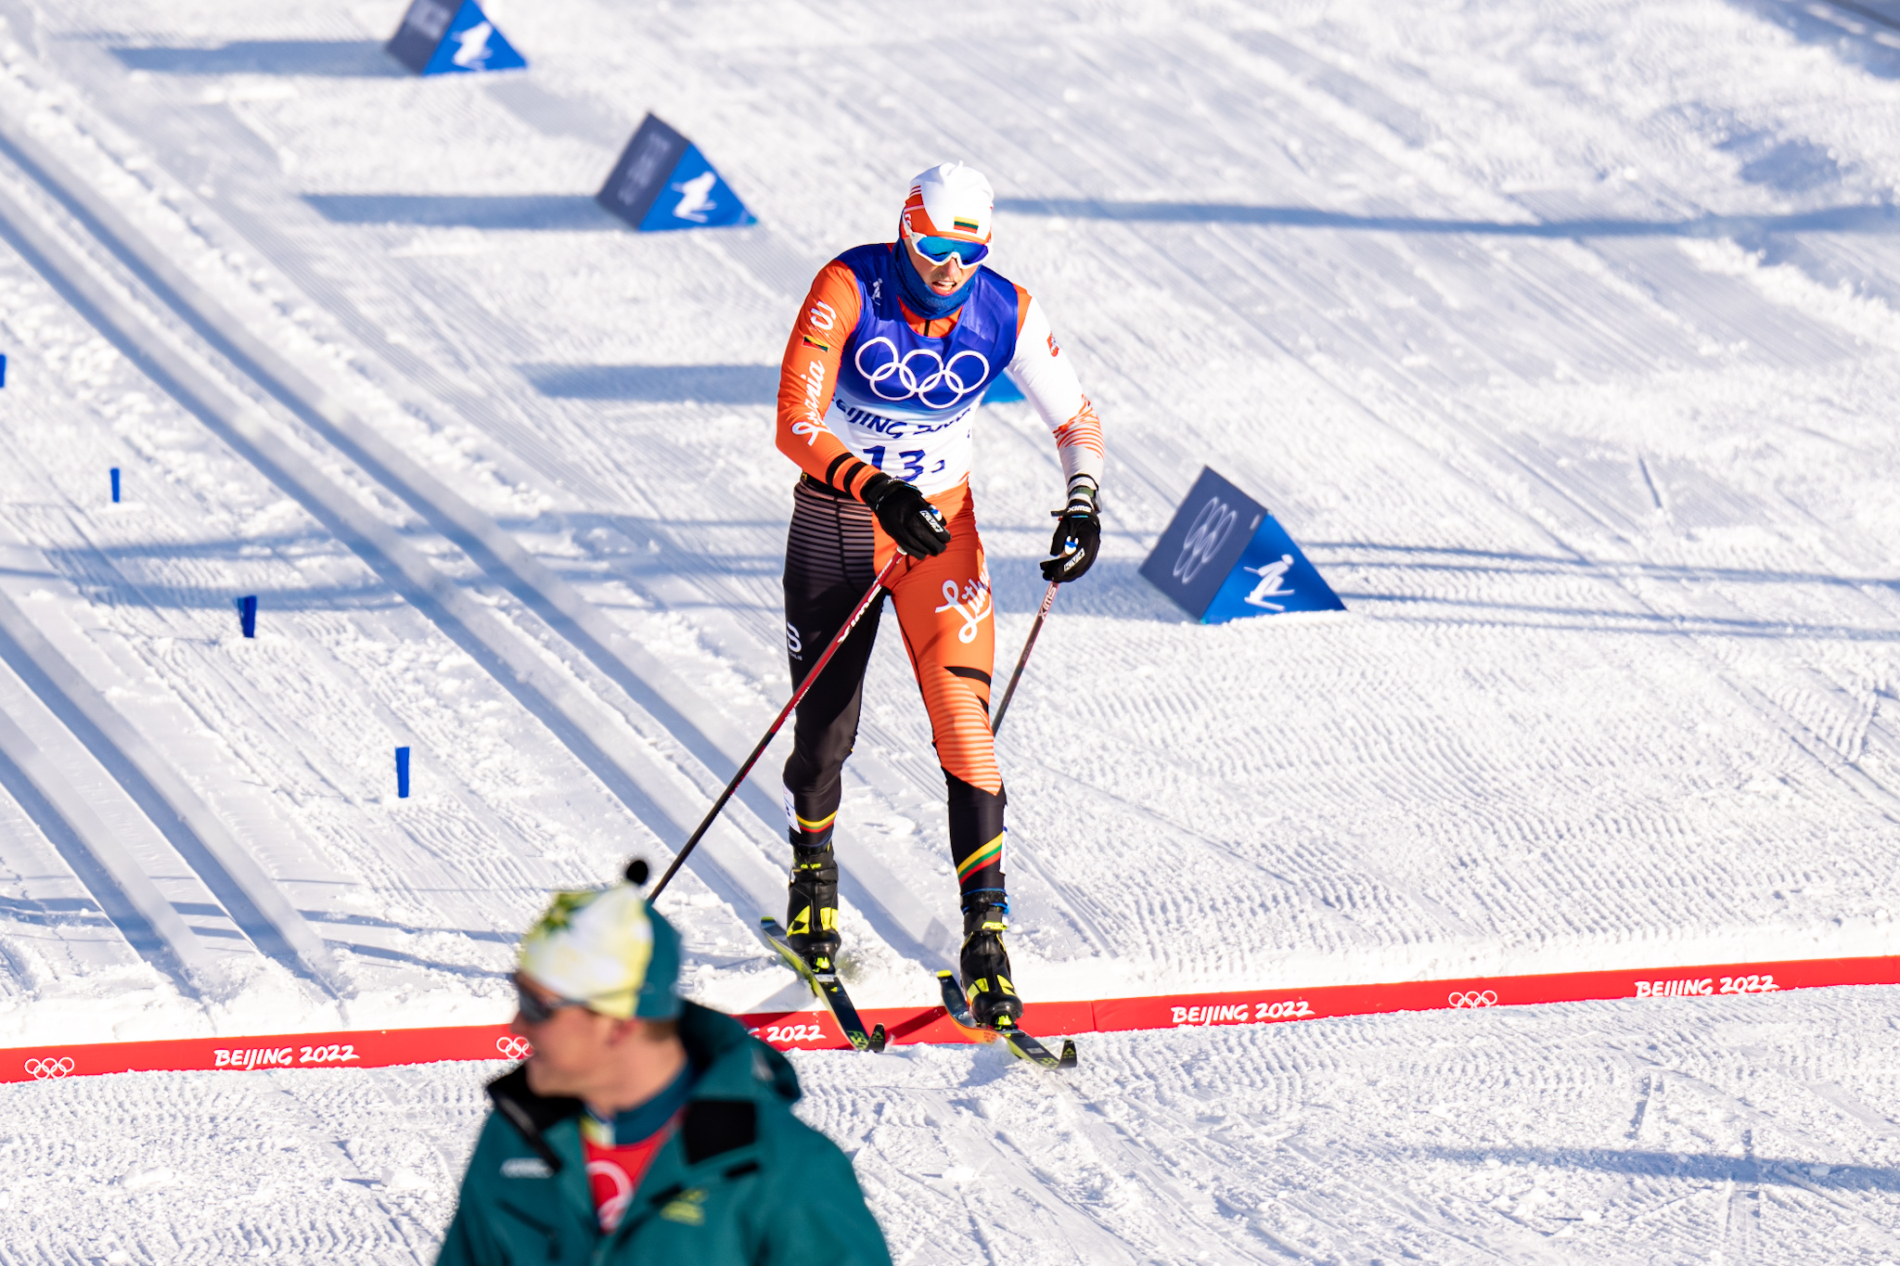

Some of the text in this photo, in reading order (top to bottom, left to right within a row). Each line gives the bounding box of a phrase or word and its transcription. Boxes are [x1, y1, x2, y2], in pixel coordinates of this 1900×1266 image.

[831, 394, 908, 439] EIJING
[1633, 974, 1781, 998] BEIJING 2022
[1170, 1000, 1316, 1026] BEIJING 2022
[767, 1024, 827, 1043] 2022
[213, 1044, 361, 1070] BEIJING 2022
